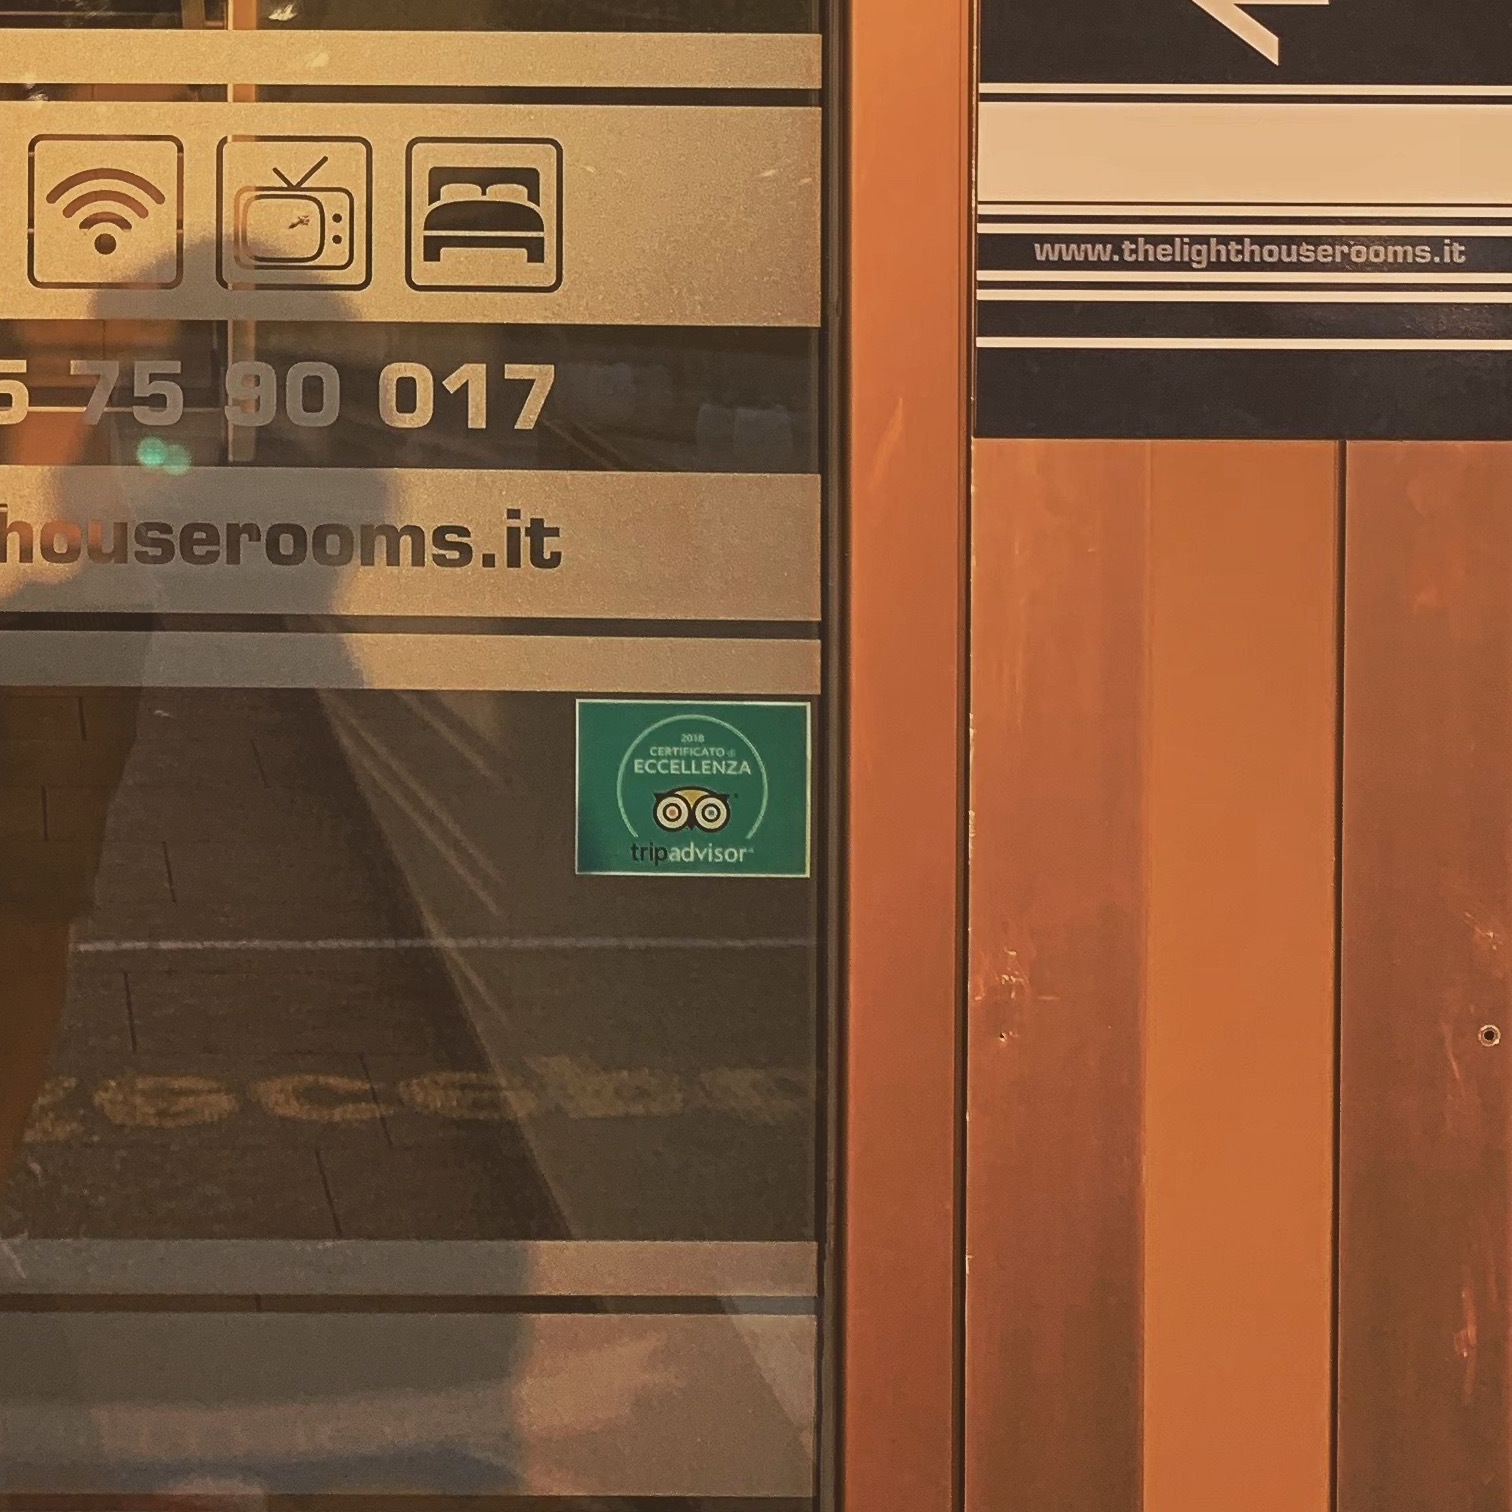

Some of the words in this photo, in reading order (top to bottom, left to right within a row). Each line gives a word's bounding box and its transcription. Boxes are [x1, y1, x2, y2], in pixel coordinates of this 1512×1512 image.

[1034, 237, 1466, 269] www.thelighthouserooms.it
[69, 359, 185, 427] 75
[224, 360, 341, 429] 90
[378, 361, 556, 431] 017
[680, 733, 705, 743] 2018
[649, 746, 725, 758] CERTIFICATO
[633, 759, 752, 775] ECCELLENZA
